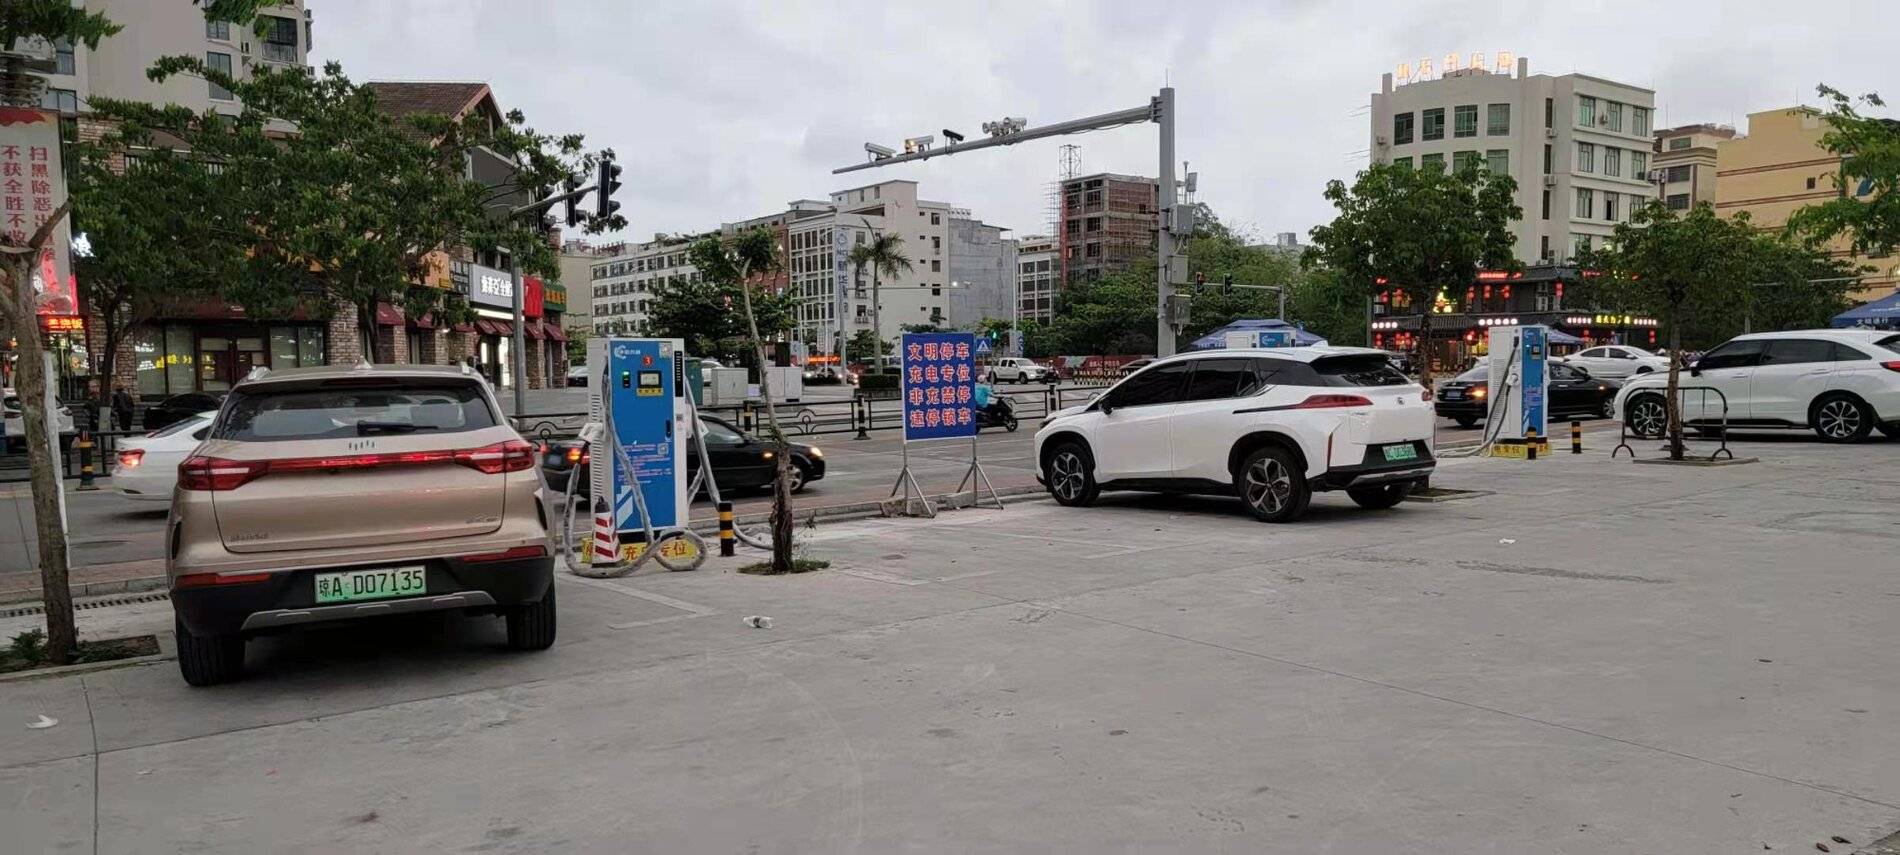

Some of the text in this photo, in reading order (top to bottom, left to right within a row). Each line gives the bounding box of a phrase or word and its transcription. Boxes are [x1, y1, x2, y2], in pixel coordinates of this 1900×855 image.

[907, 341, 970, 361] 文明停车
[908, 363, 971, 384] 充电专位
[909, 385, 971, 406] 非充禁停
[910, 407, 972, 428] 违停锁车
